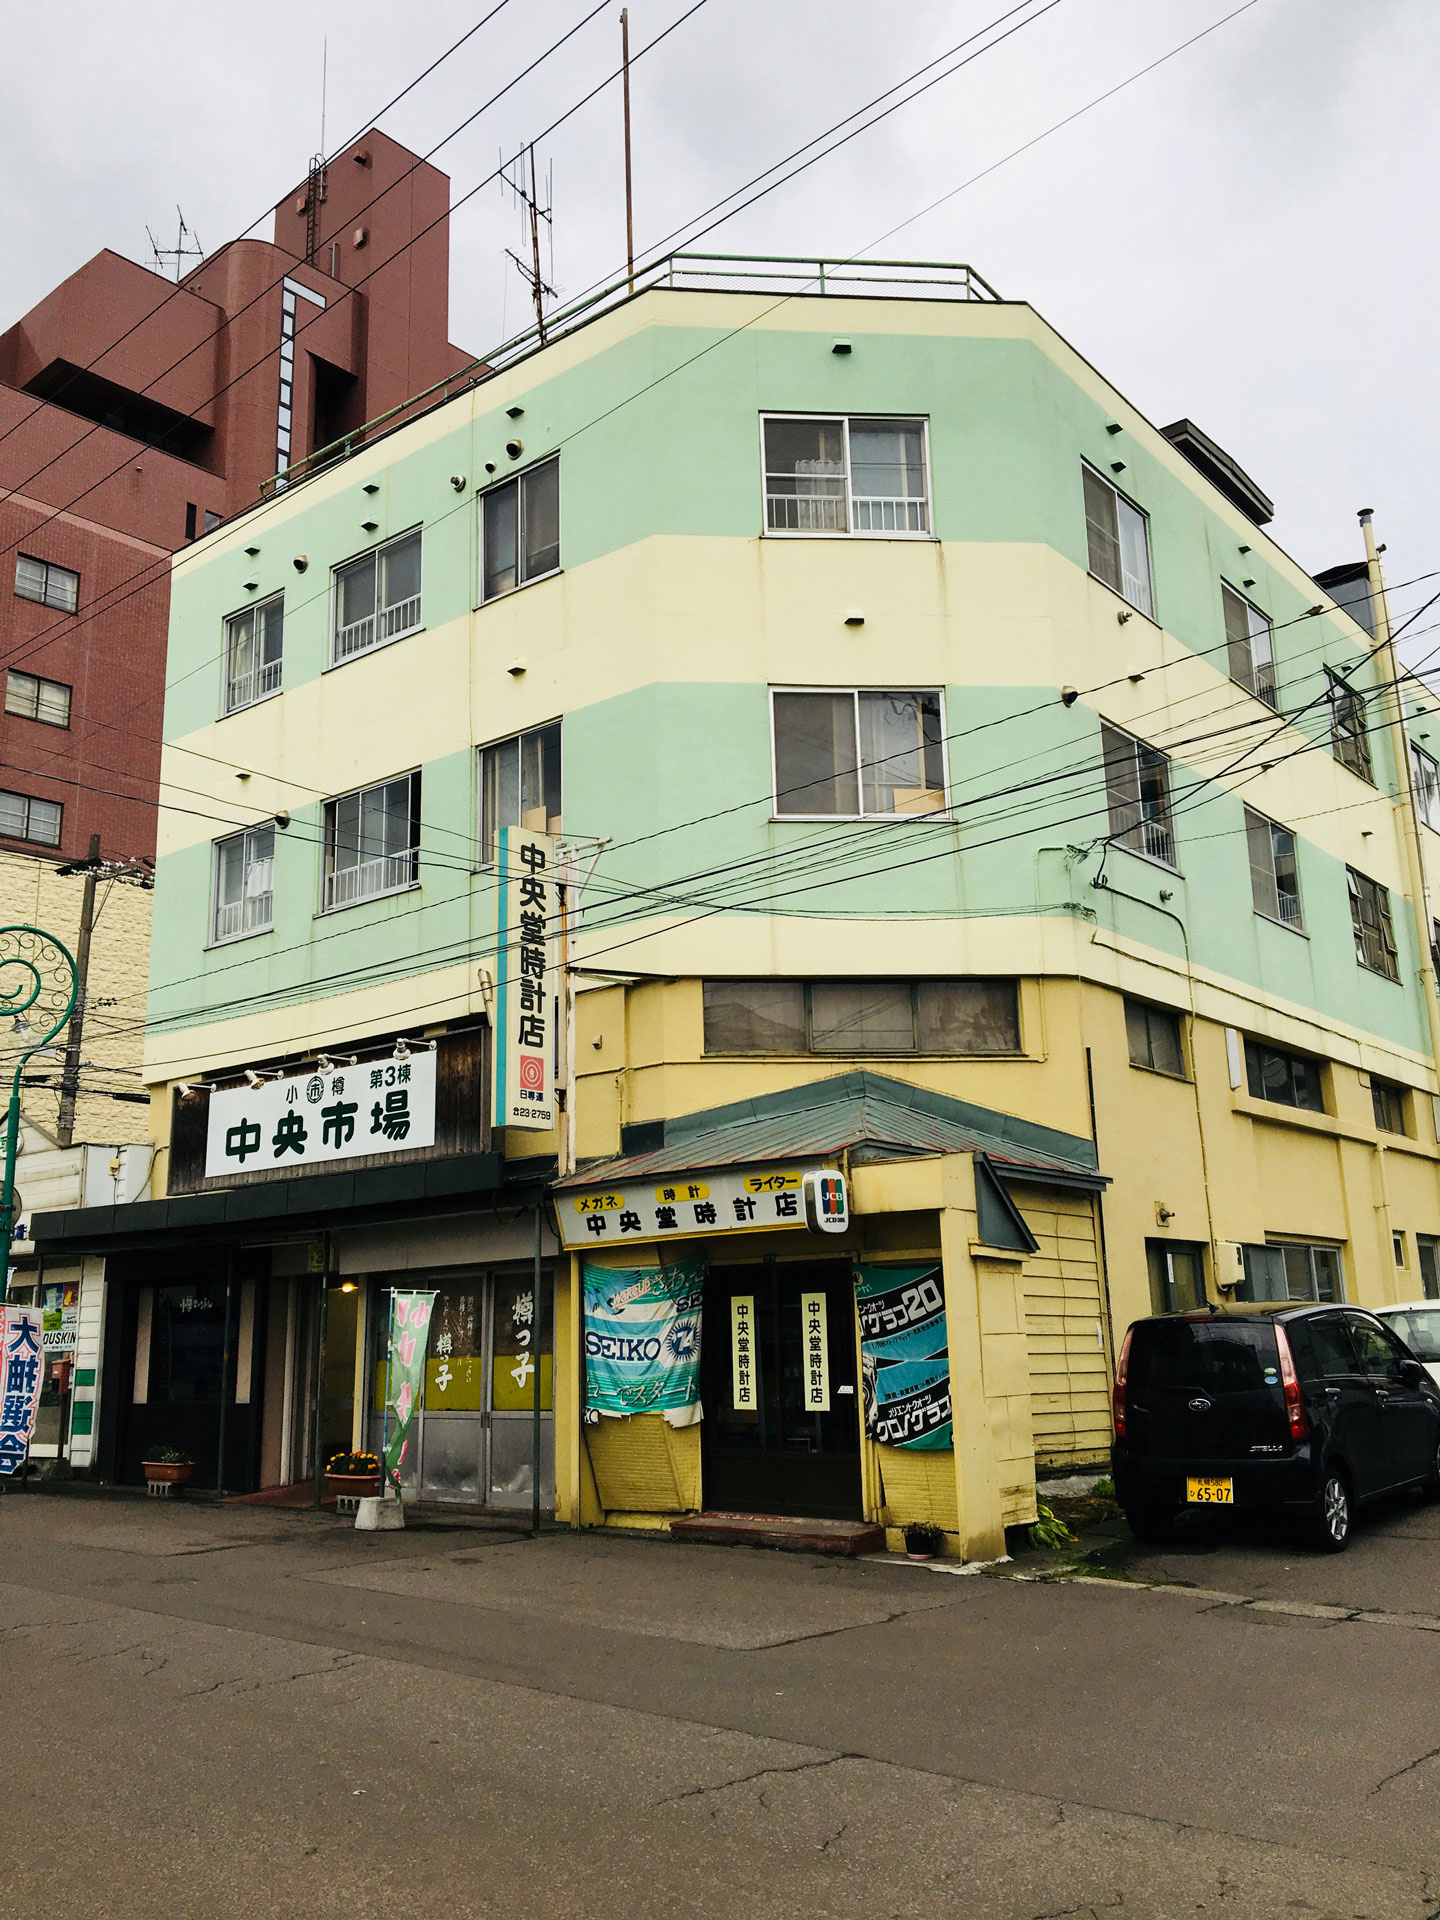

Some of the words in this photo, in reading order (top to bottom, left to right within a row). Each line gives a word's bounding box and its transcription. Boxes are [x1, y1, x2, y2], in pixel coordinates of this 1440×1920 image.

[518, 843, 546, 1048] 中央堂時計店
[370, 1064, 411, 1089] 第3棟
[225, 1089, 410, 1163] 中央市場
[580, 1195, 617, 1211] メガネ
[663, 1186, 700, 1200] 時計
[749, 1176, 798, 1192] ライター
[823, 1192, 843, 1200] JCB
[586, 1192, 798, 1236] 中央堂時計店
[585, 1331, 661, 1362] SEIKO
[737, 1303, 751, 1403] 中央堂時計店
[808, 1301, 823, 1403] 中央堂時計店
[586, 1375, 697, 1406] コーでスタート
[1197, 1488, 1231, 1501] 65-07
